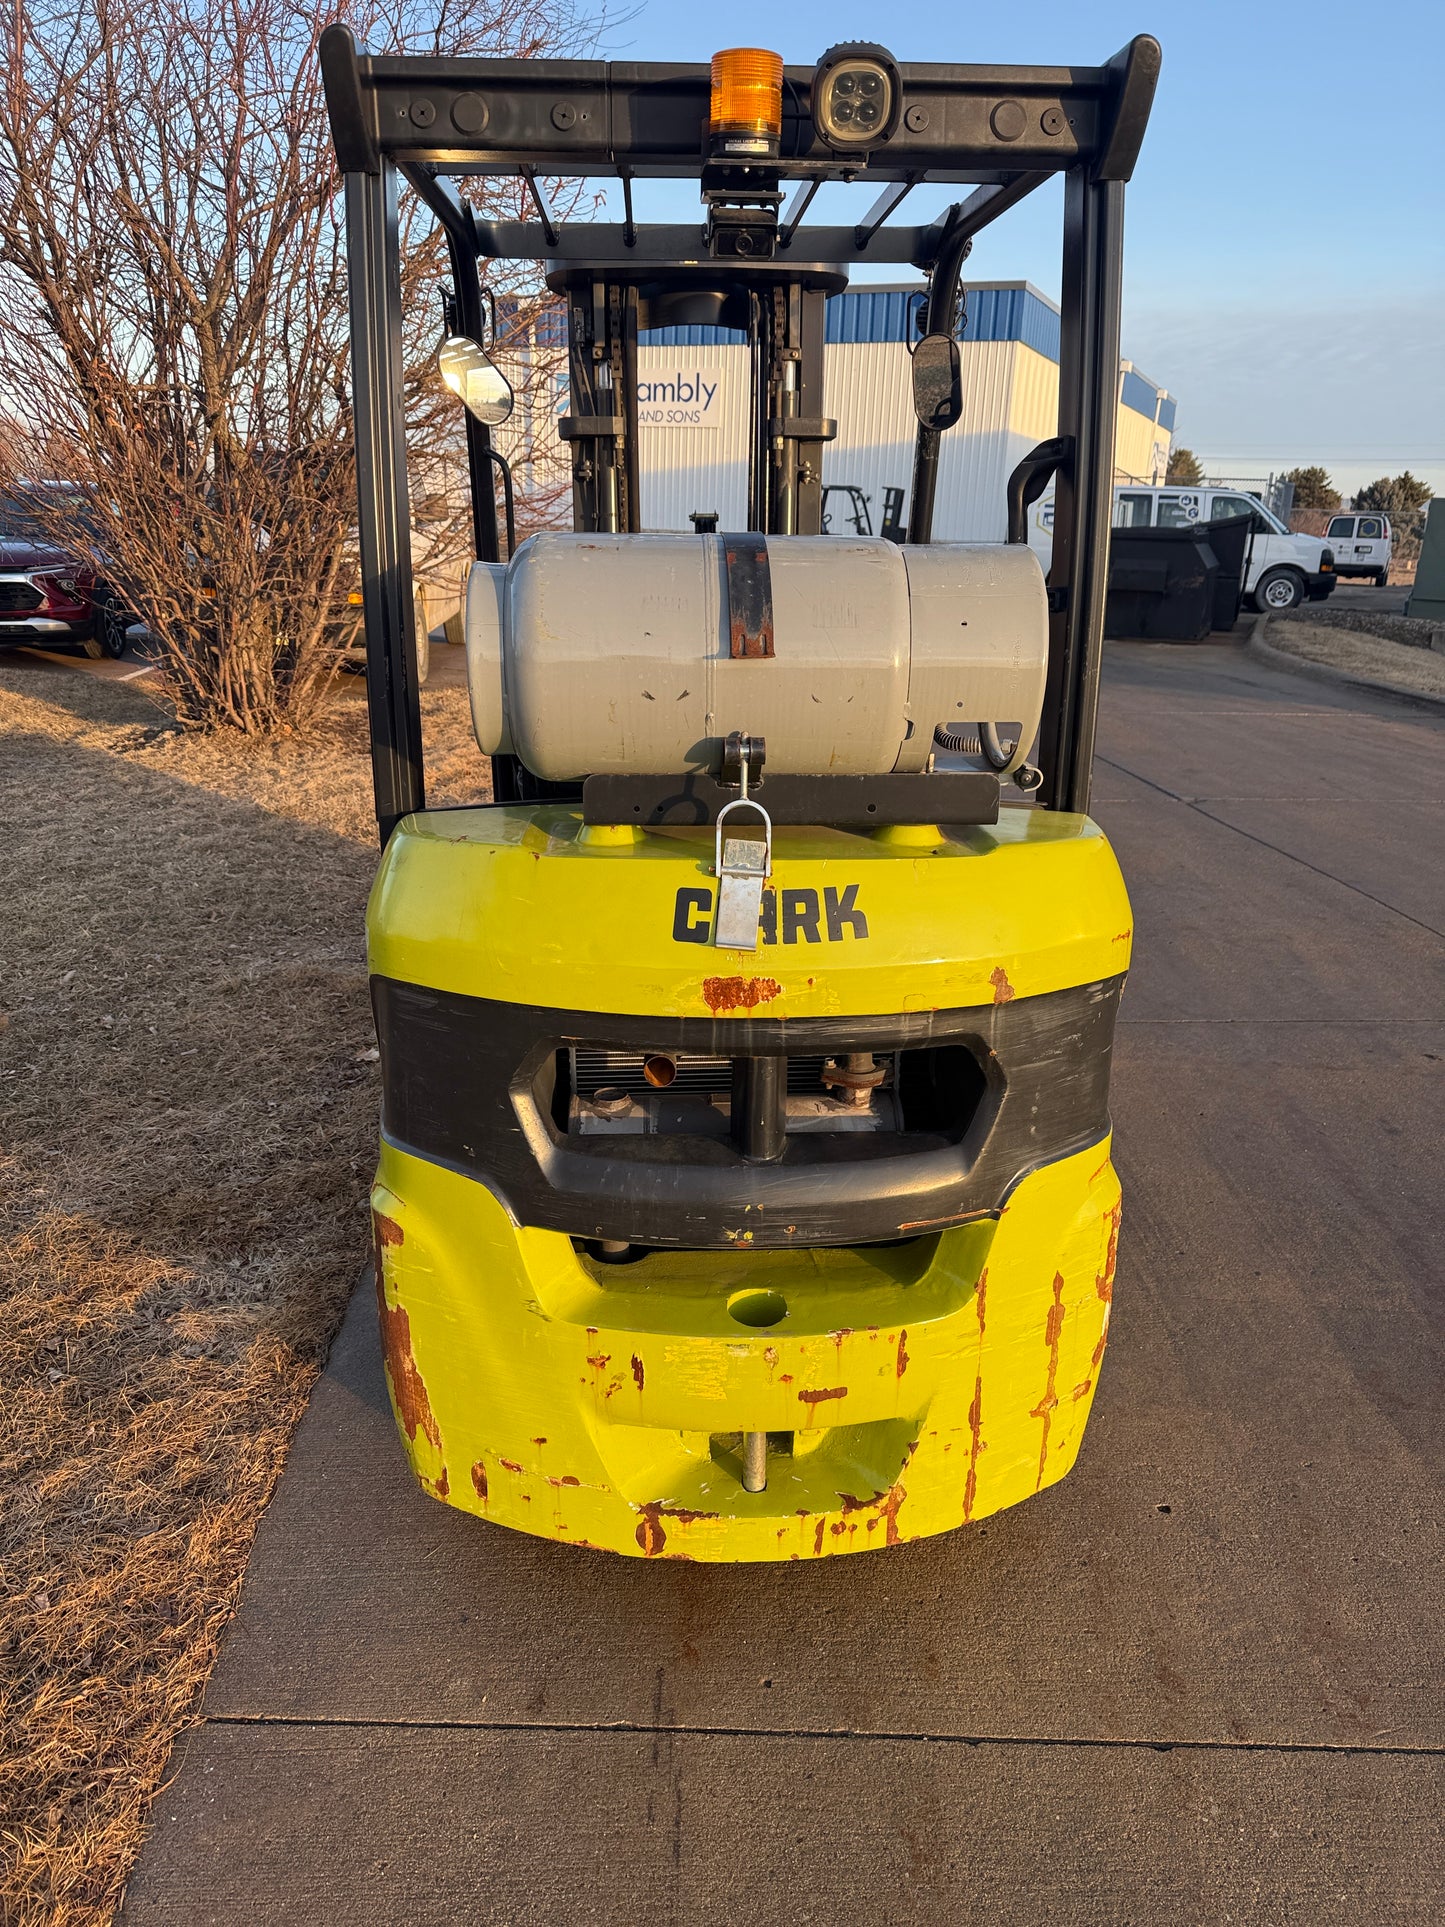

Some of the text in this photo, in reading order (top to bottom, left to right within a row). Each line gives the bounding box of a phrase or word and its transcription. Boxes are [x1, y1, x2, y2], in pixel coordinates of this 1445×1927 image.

[637, 372, 717, 411] ambly
[638, 410, 701, 424] AND SONS
[672, 884, 869, 945] CARK
